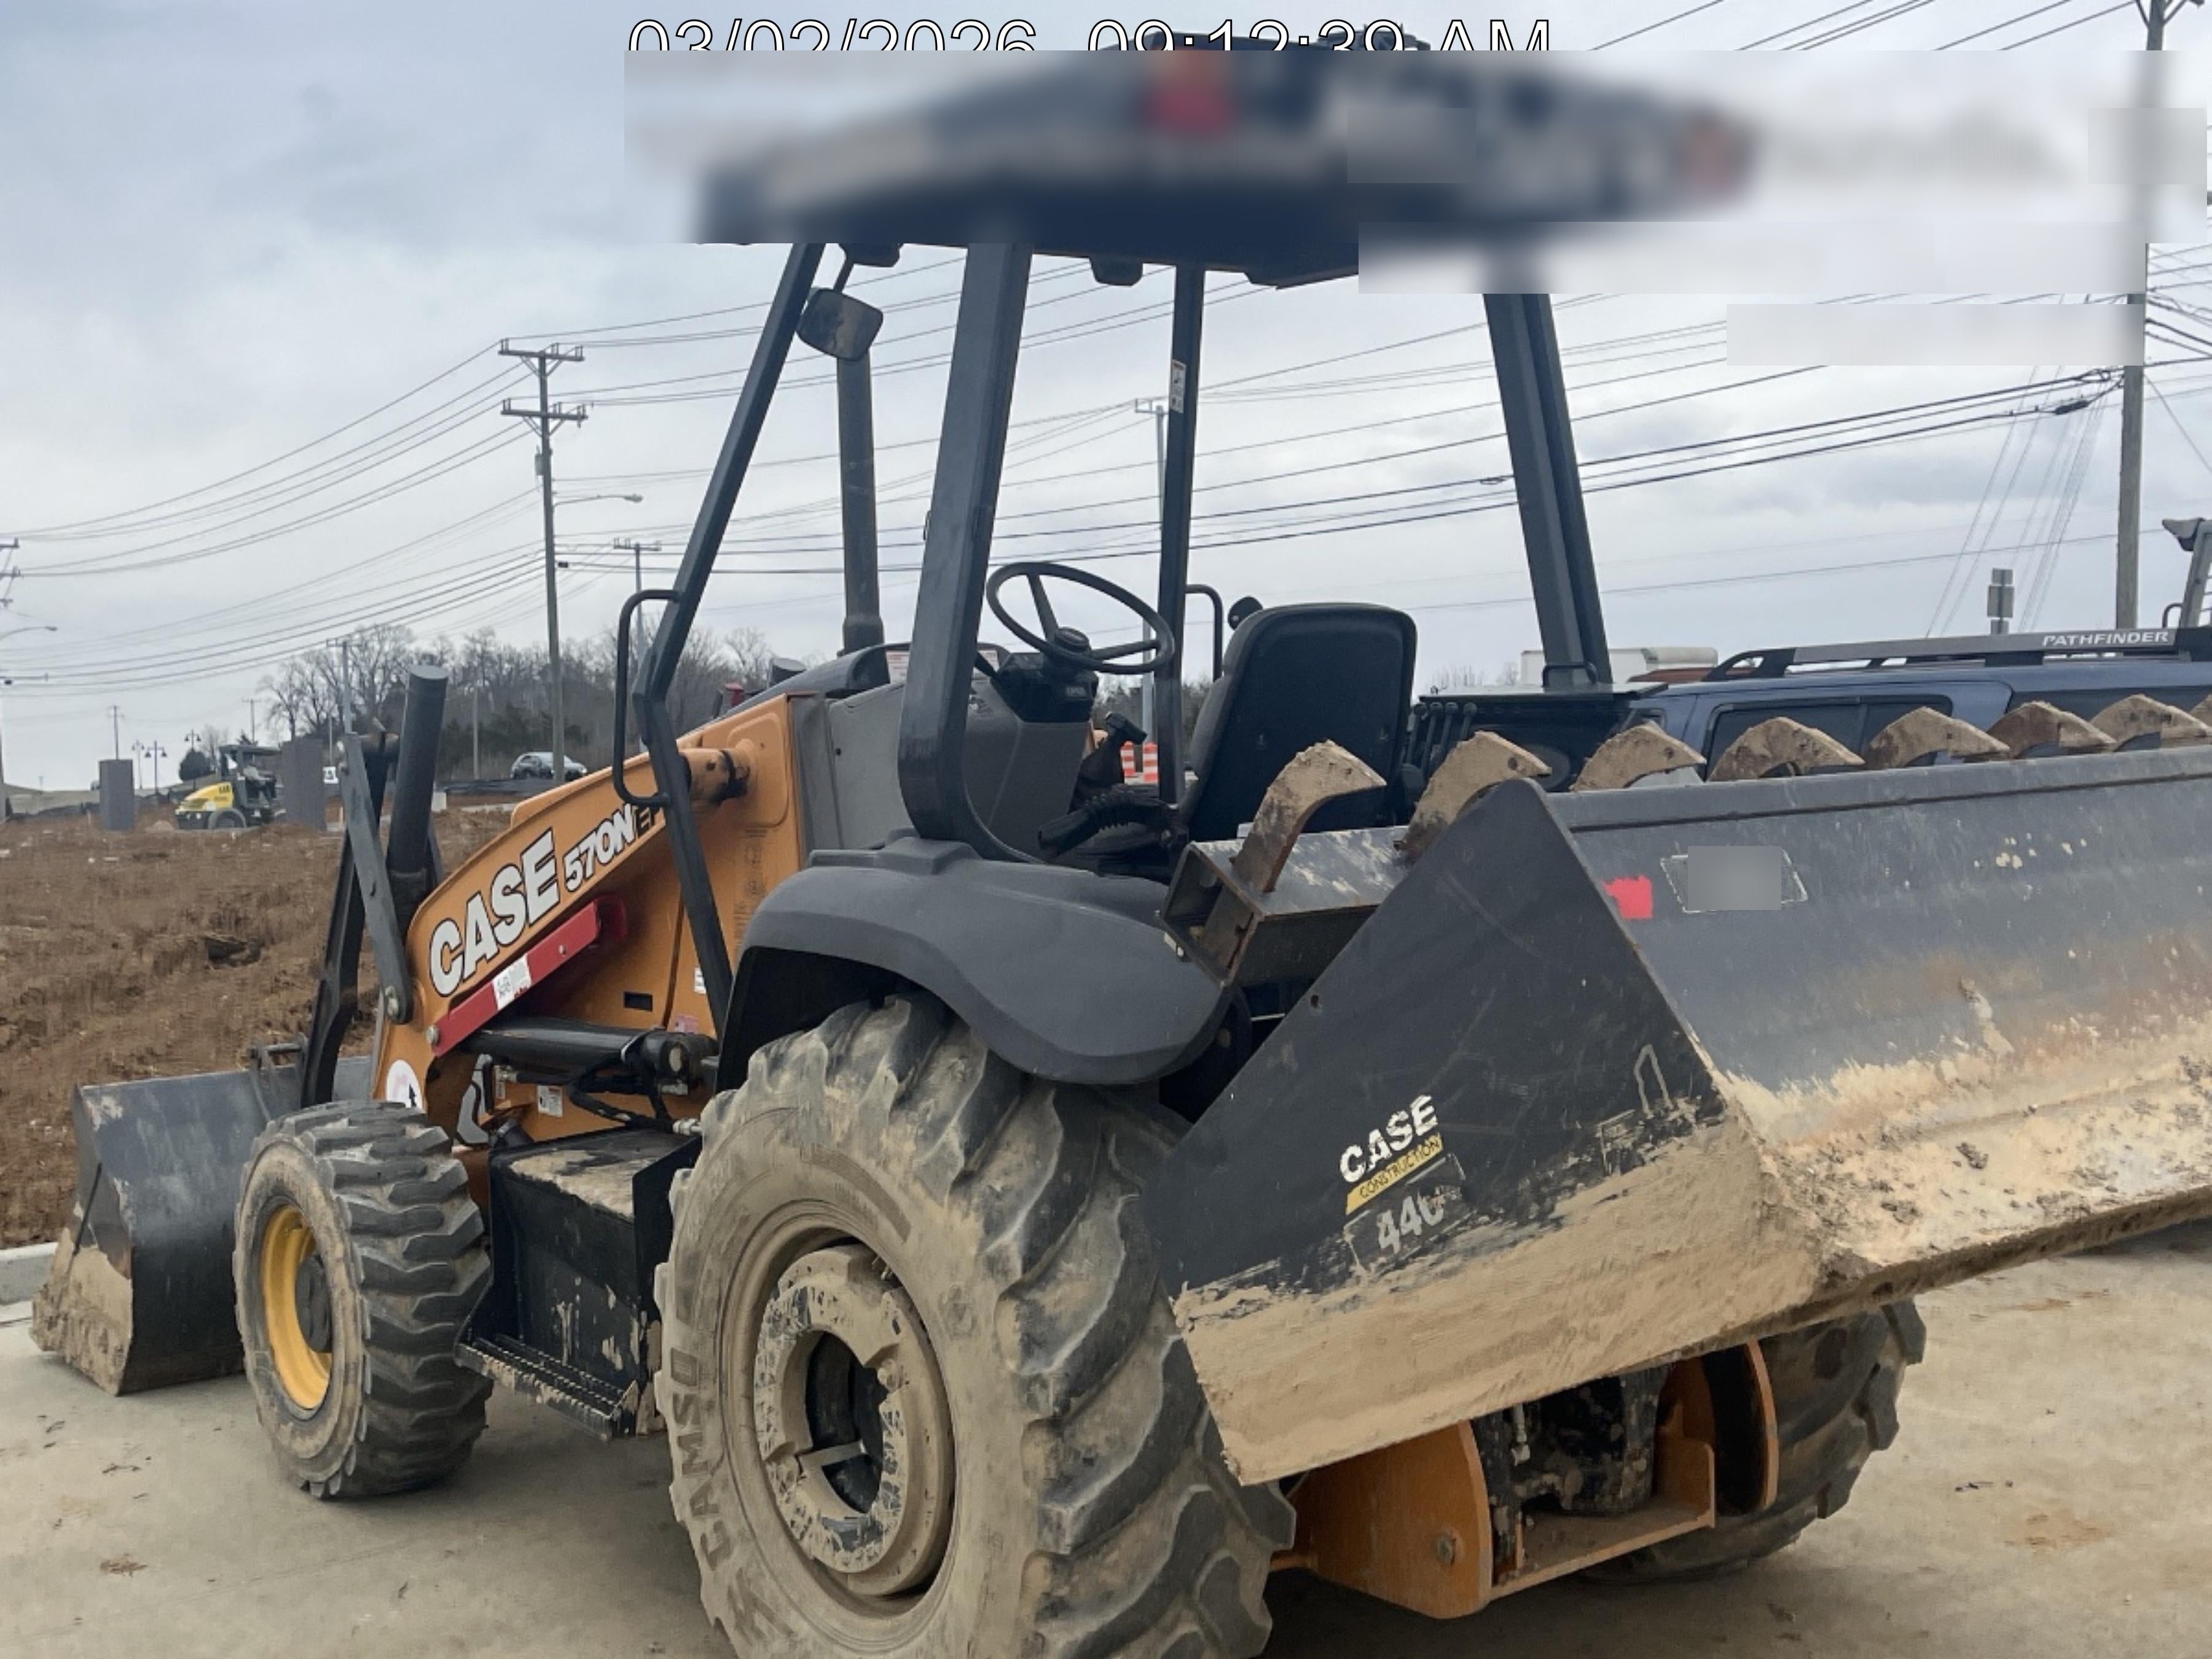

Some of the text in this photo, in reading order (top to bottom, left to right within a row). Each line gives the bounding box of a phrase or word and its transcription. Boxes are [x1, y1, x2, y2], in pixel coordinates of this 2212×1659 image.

[2042, 631, 2168, 646] PATHFINDER
[429, 827, 560, 997] CASE
[1339, 1095, 1438, 1182] CASE
[1359, 1139, 1439, 1199] CONSTRUCTION
